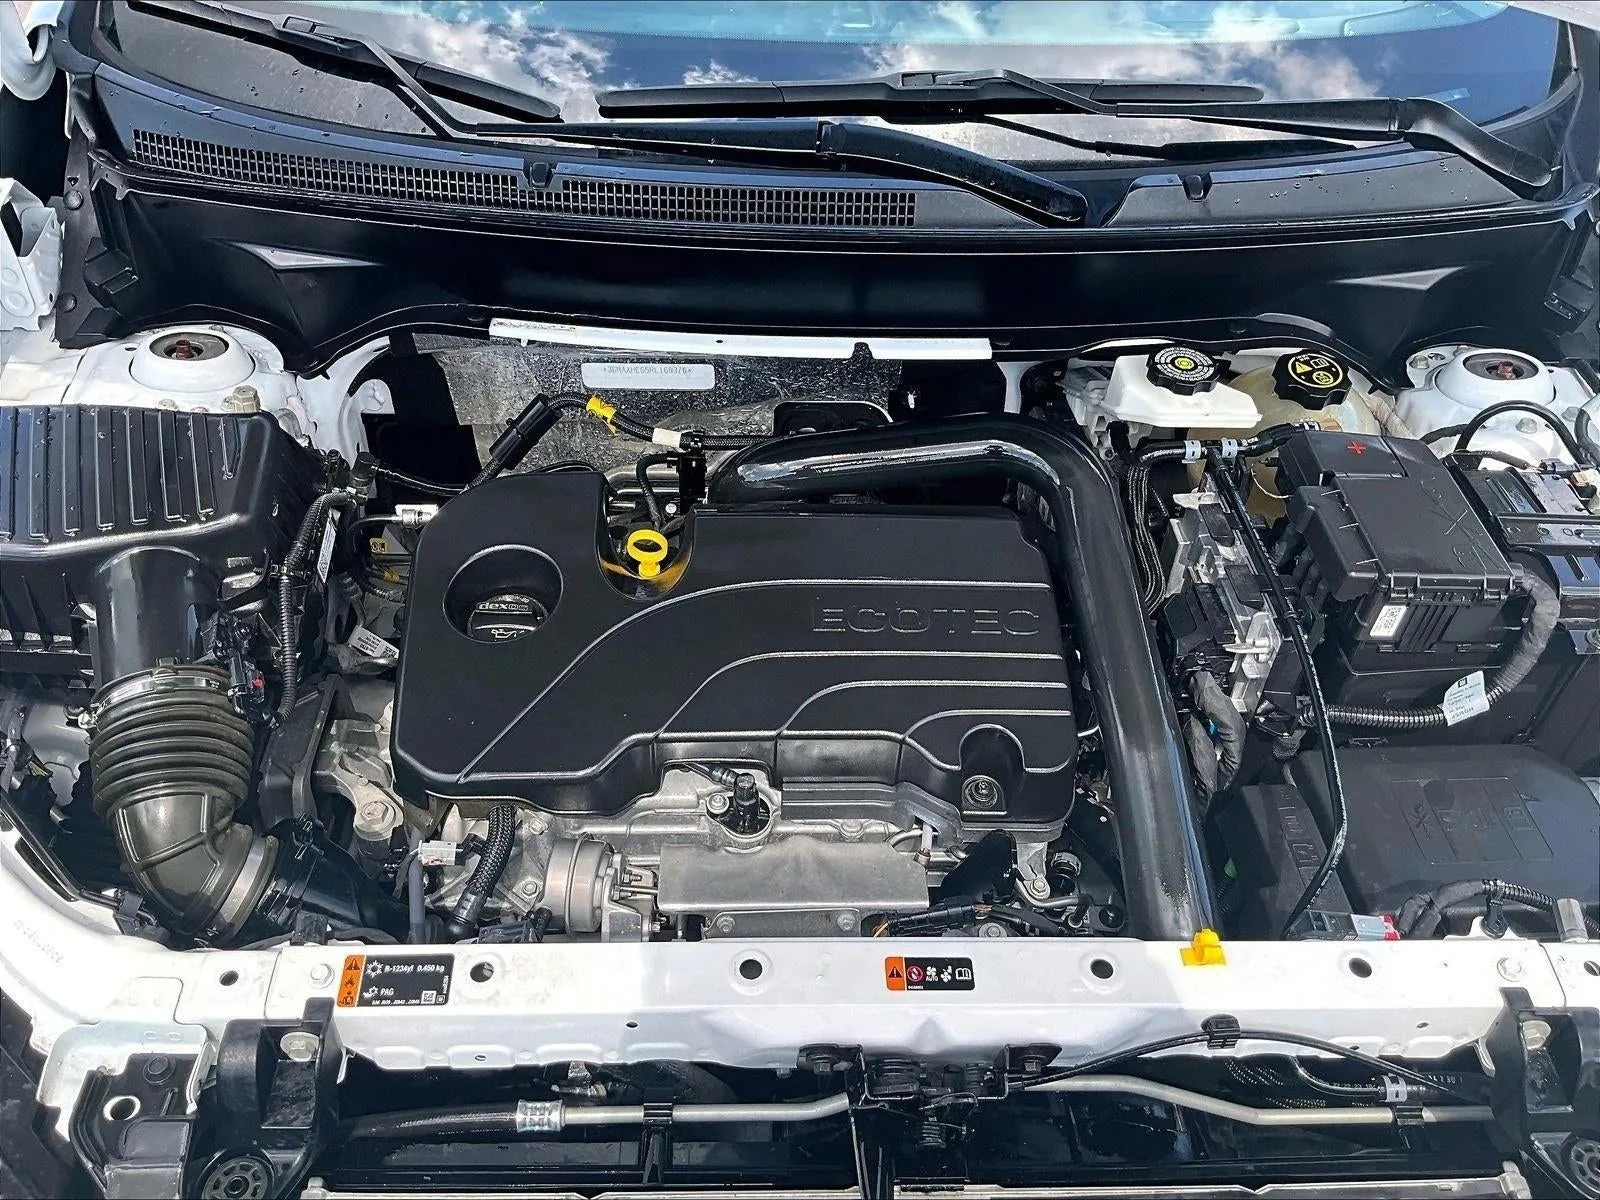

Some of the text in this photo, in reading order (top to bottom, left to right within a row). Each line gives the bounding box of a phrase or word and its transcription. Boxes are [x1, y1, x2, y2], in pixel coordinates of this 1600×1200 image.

[479, 602, 529, 611] dexos
[812, 606, 1040, 635] ECOTEC
[417, 964, 435, 972] 0.450
[435, 964, 445, 973] kg
[380, 988, 394, 996] PAG
